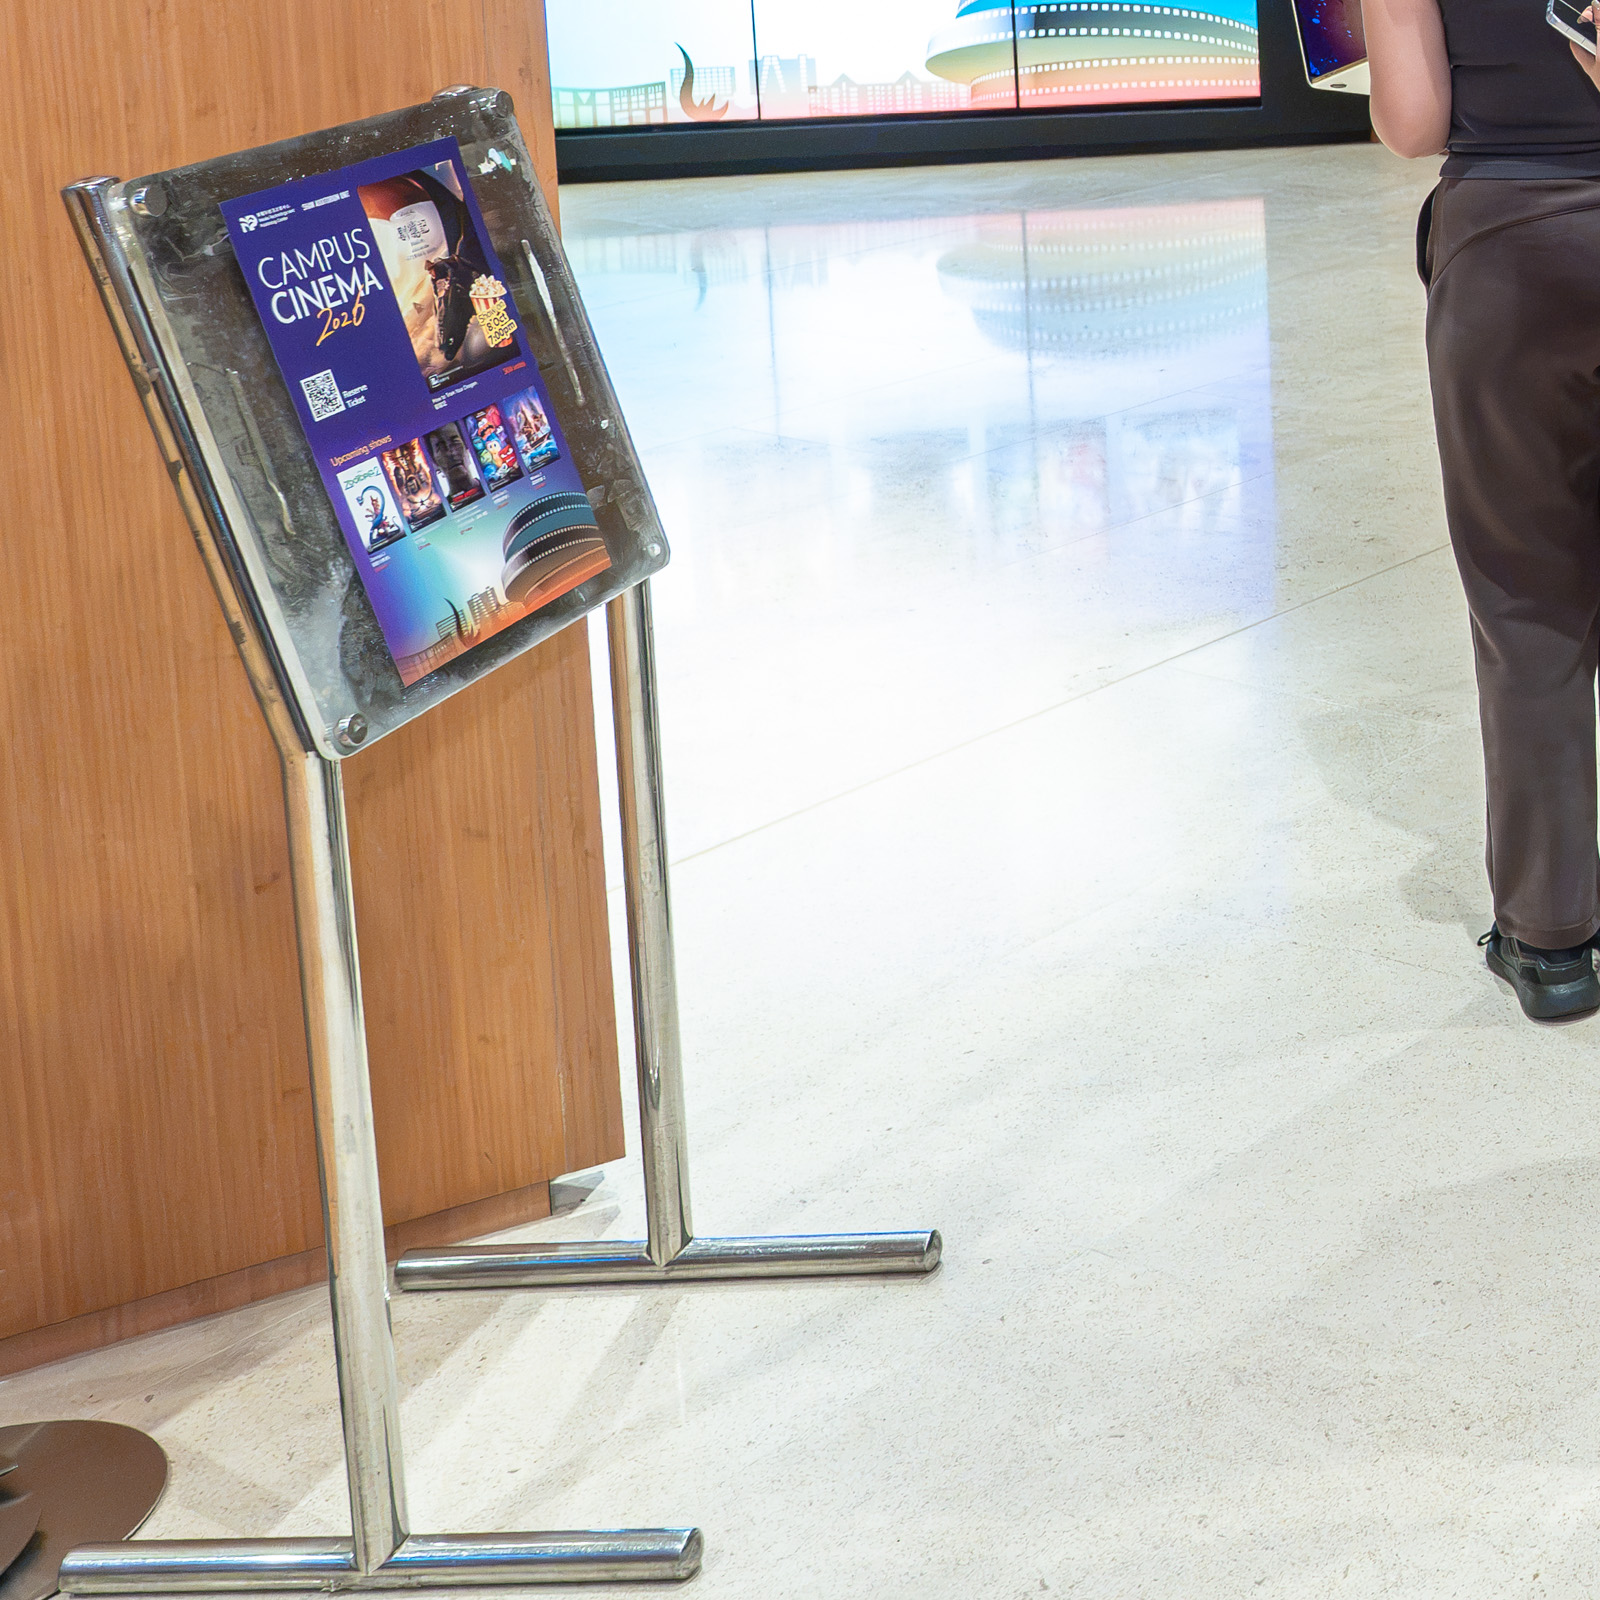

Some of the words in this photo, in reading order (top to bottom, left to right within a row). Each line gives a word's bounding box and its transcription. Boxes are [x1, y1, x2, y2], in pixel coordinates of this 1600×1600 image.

[257, 228, 370, 289] CAMPUS
[271, 261, 384, 325] CINEMA
[315, 283, 365, 347] 2026
[330, 445, 370, 467] Upcoming
[369, 434, 392, 450] shows
